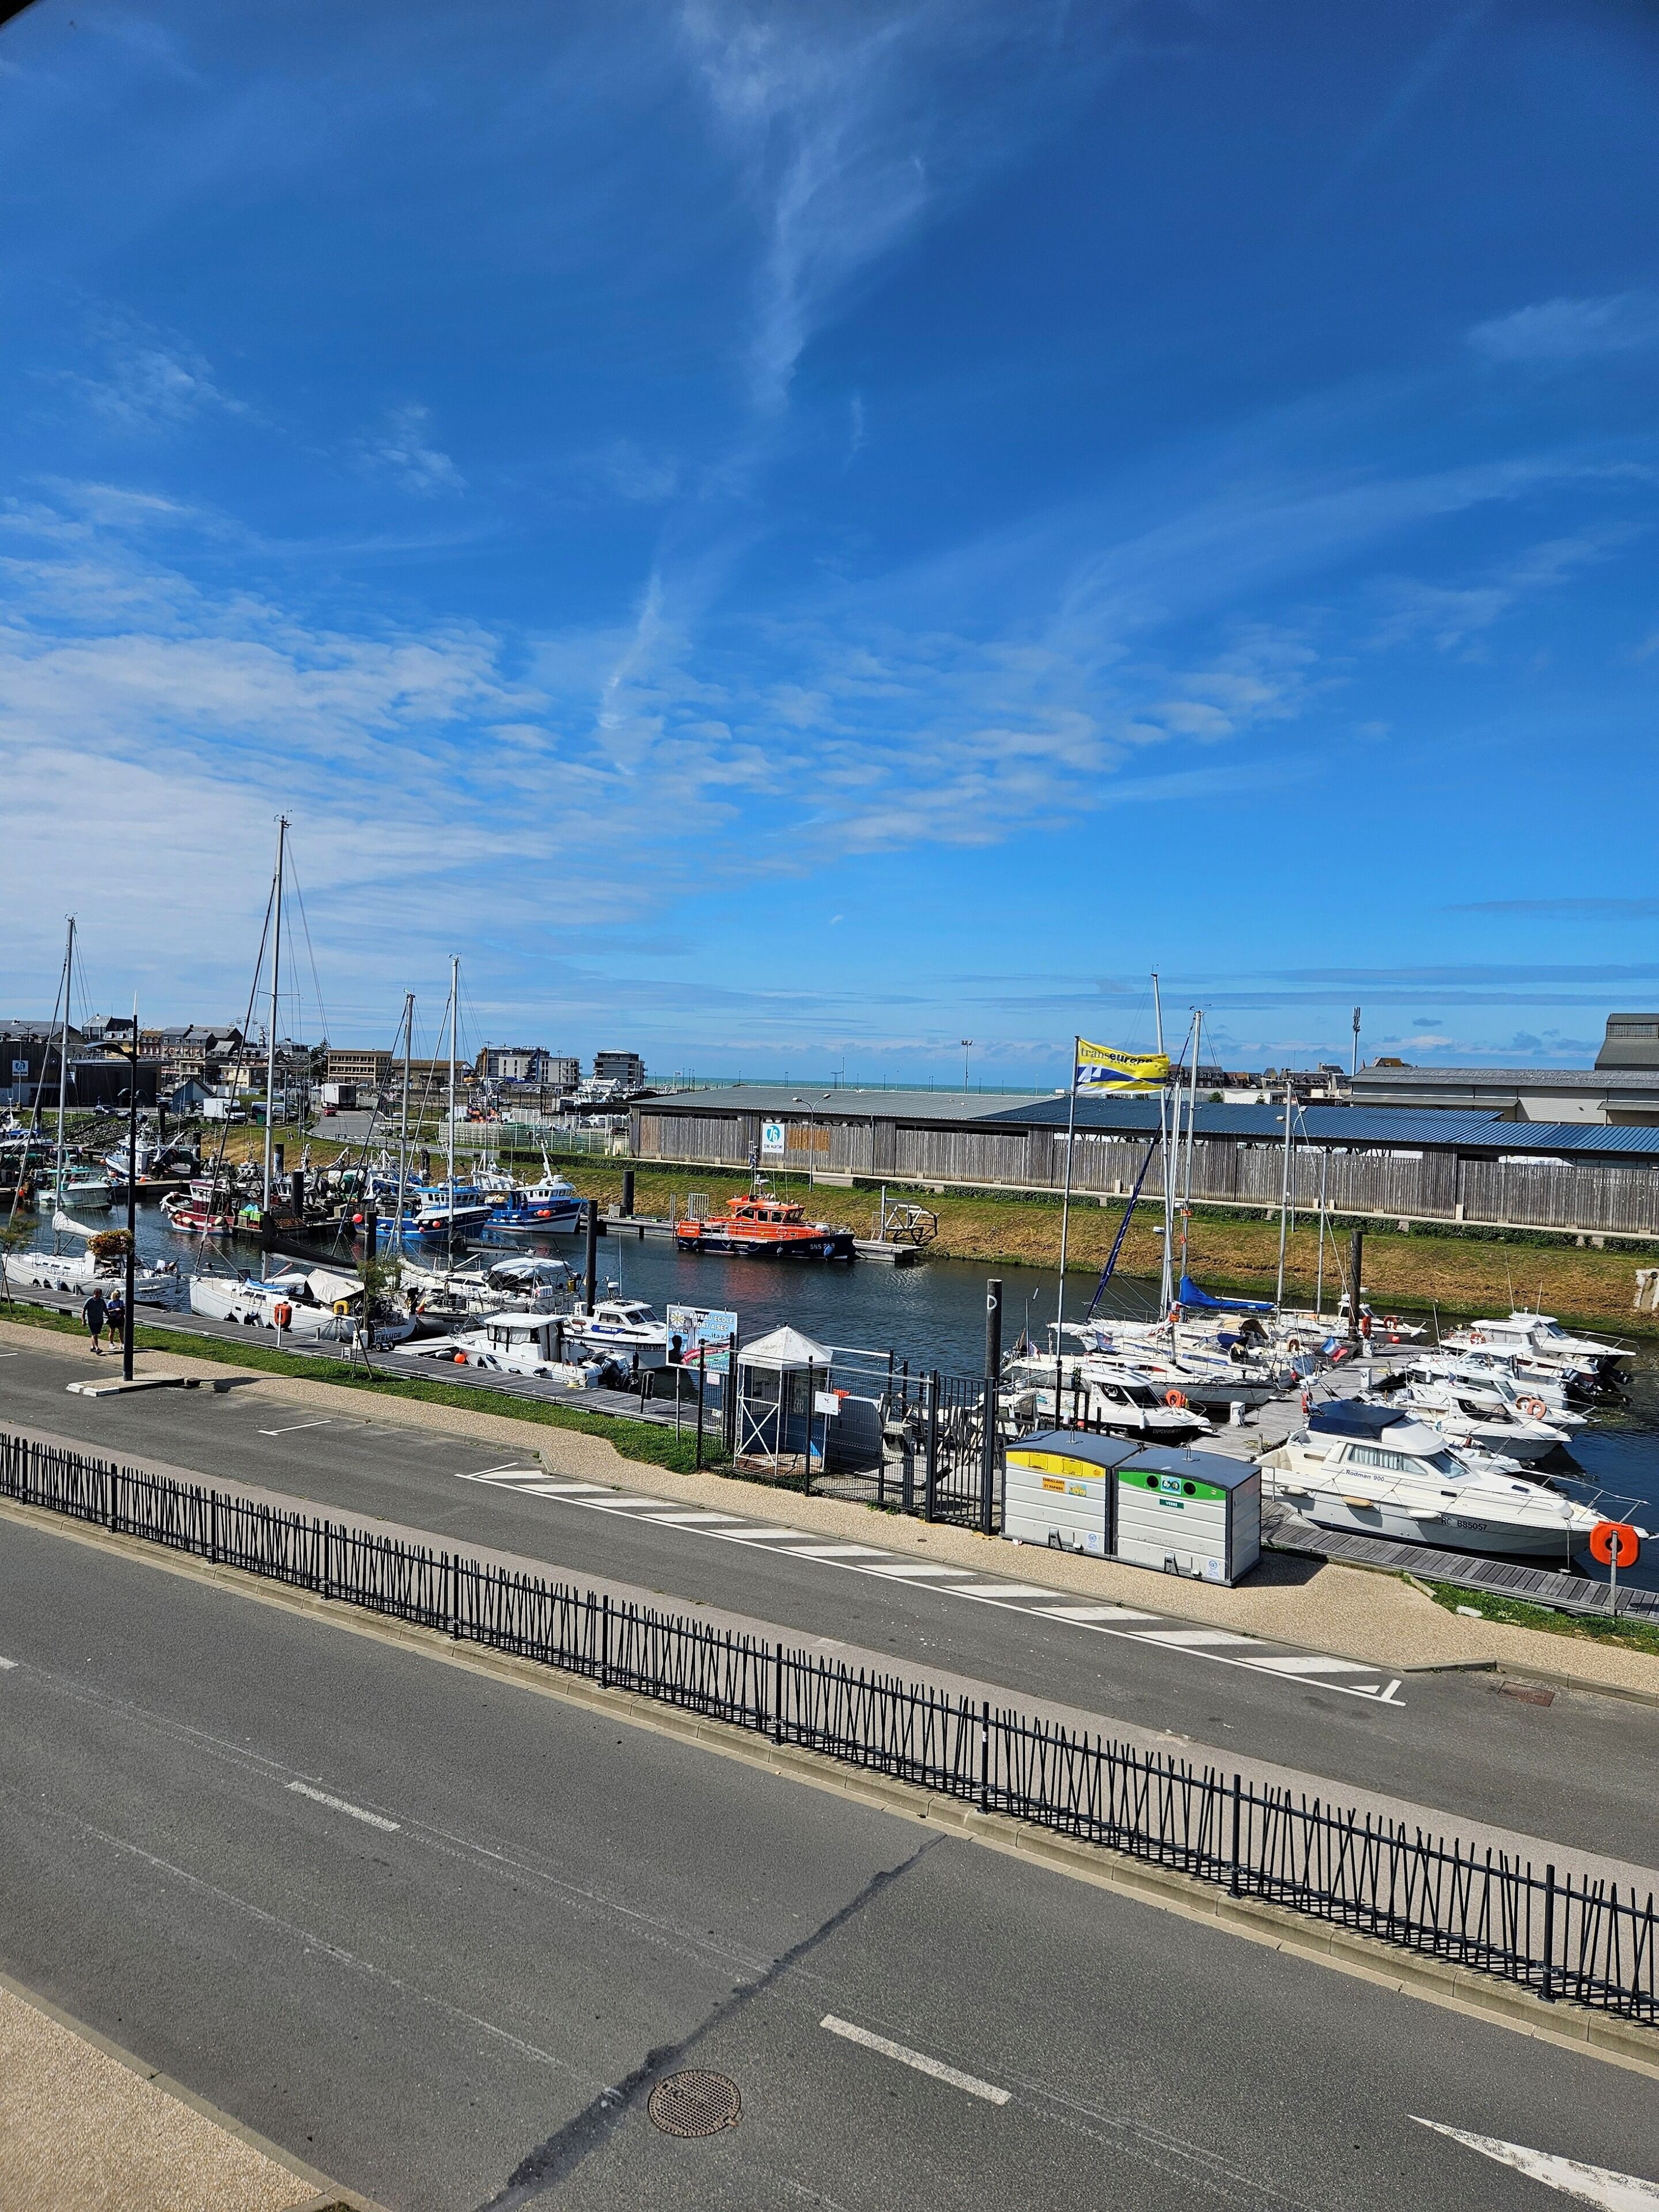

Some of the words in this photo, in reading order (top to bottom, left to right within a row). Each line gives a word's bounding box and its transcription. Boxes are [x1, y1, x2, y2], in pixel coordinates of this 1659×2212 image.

[767, 1126, 778, 1142] 76
[987, 1294, 998, 1310] D
[690, 1312, 713, 1321] BATEAU
[714, 1316, 734, 1324] ECOLE
[1346, 1469, 1371, 1479] Rodman
[1441, 1517, 1452, 1526] RC
[1457, 1520, 1487, 1531] B85057
